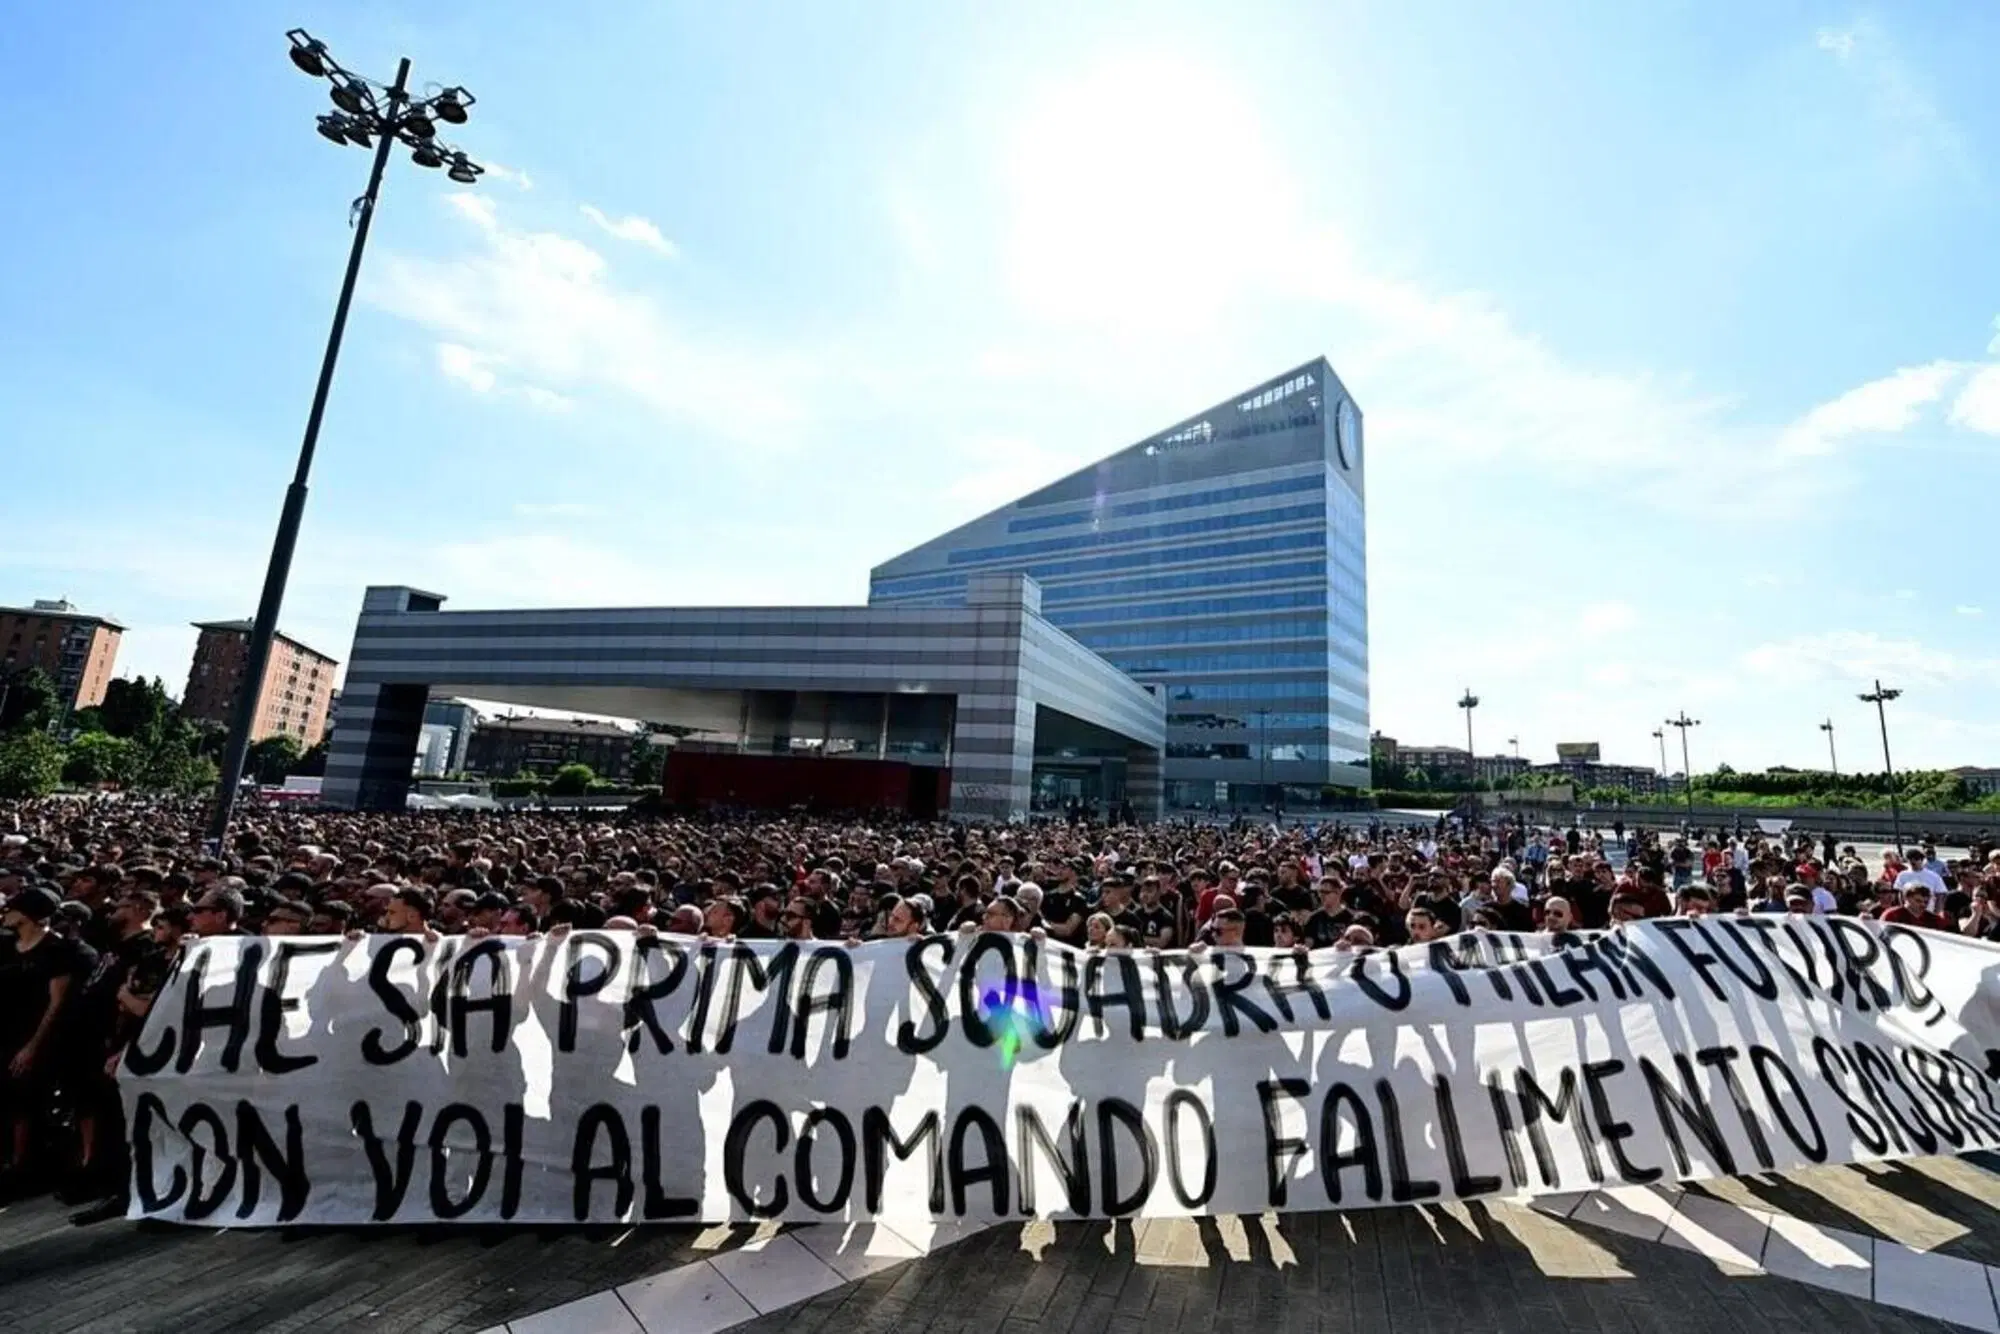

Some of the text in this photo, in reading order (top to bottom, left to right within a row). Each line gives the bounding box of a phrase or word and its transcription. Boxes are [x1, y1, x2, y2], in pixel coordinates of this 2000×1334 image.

[361, 937, 513, 1066] SIA
[556, 931, 854, 1060] PRIMA
[897, 932, 1331, 1056] SQUADRA
[1428, 929, 1676, 1008] MILAN
[135, 1092, 310, 1222] CON
[350, 1100, 524, 1222] VOI
[571, 1102, 698, 1222] AL
[723, 1088, 1218, 1217] COMANDO
[1256, 1044, 1828, 1207] FALLIMENTO
